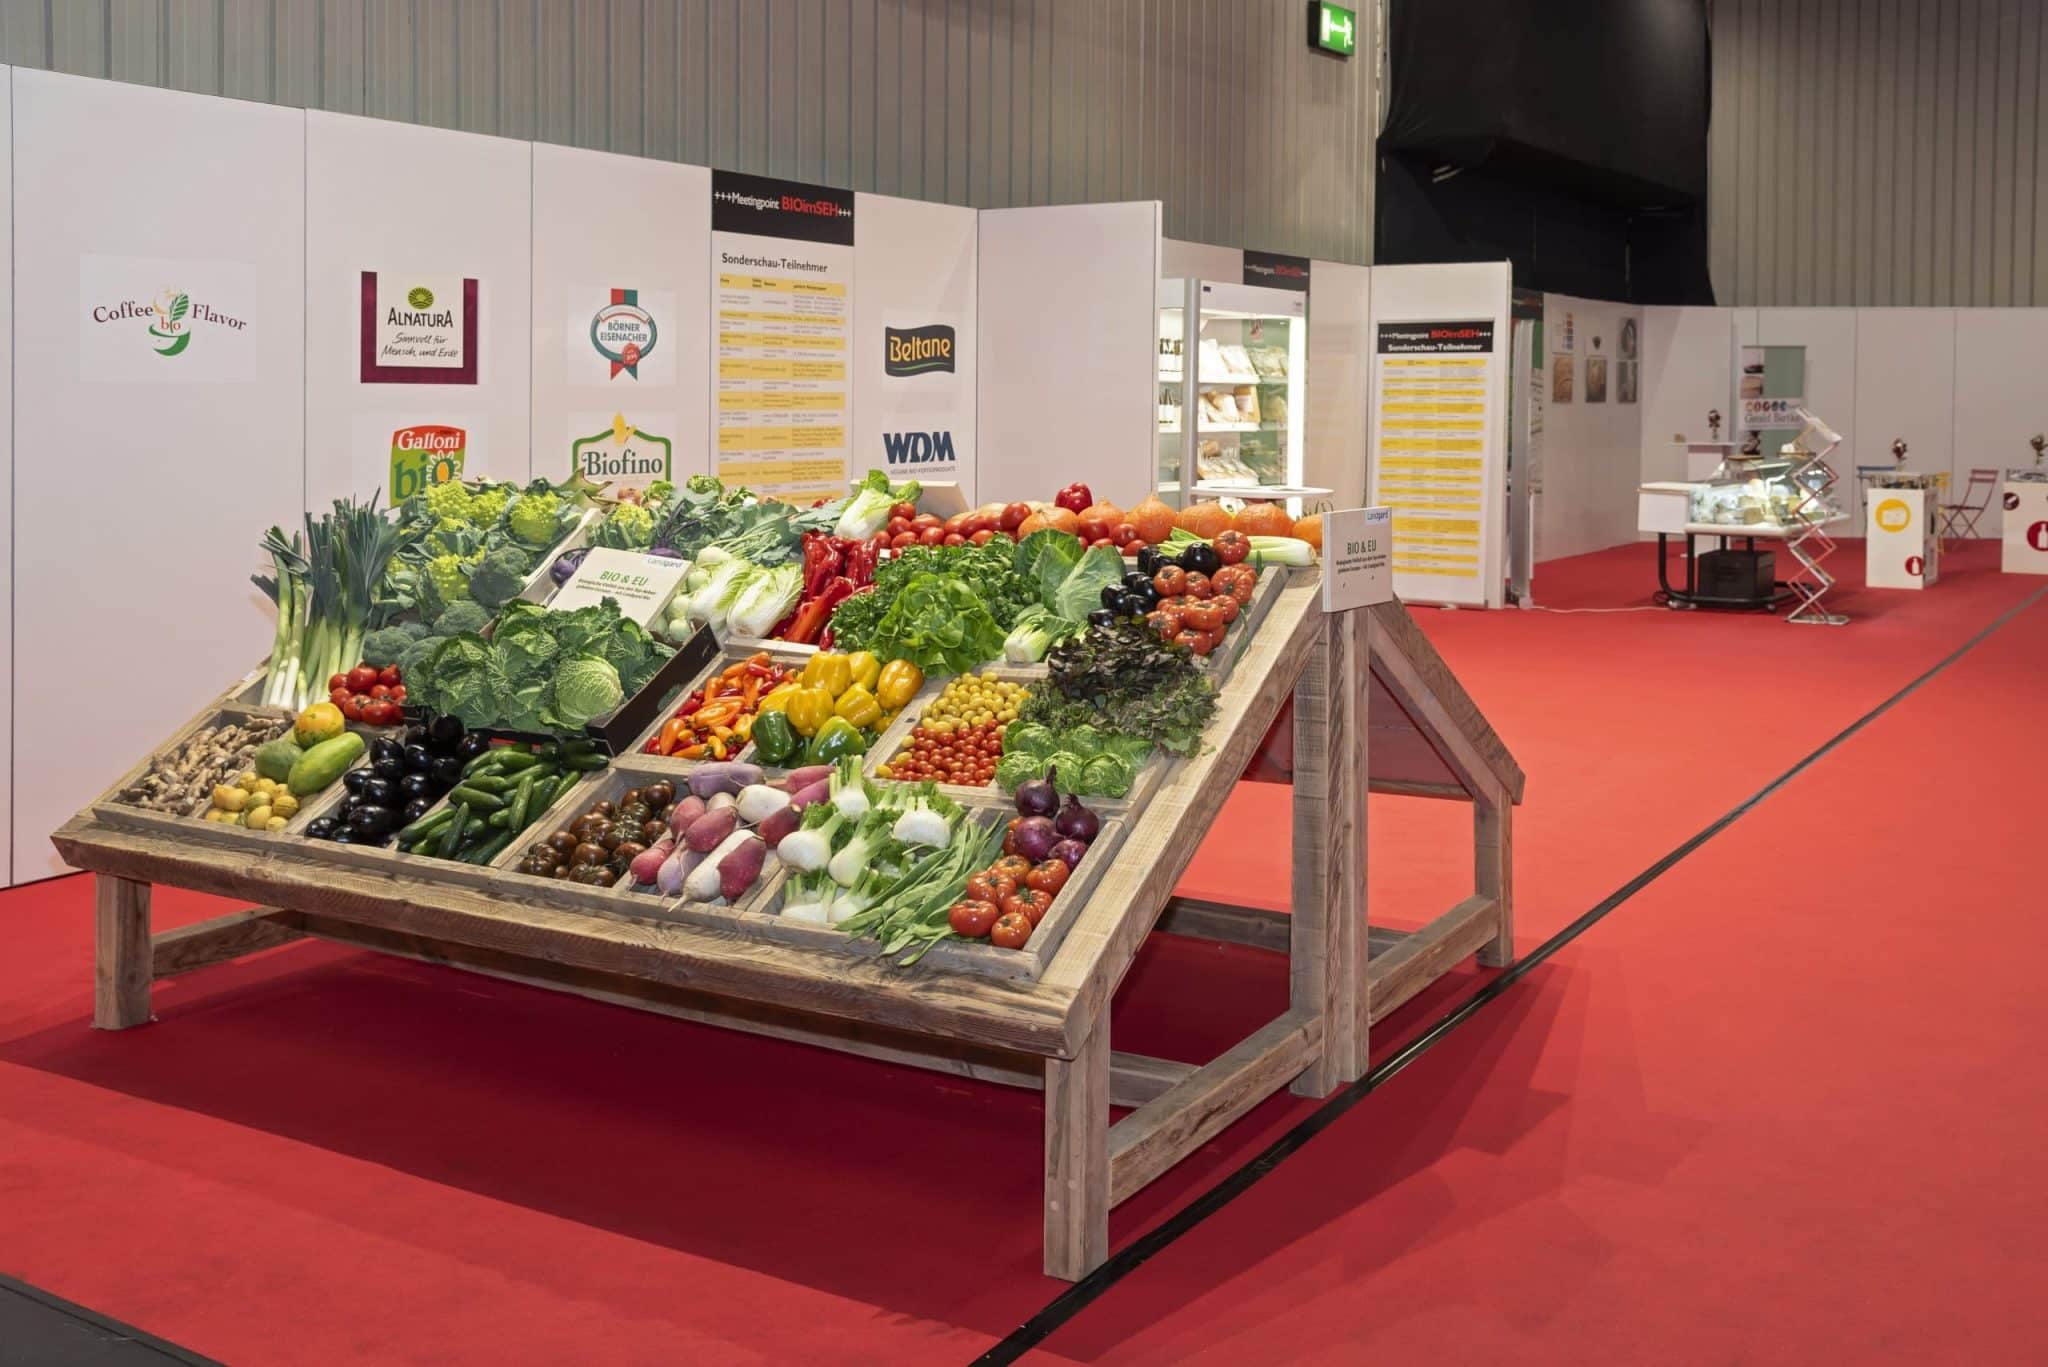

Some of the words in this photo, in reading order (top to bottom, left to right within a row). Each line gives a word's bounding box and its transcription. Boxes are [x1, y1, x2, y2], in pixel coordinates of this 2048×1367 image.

[721, 252, 828, 273] Sonderschau-Teilnehmer
[93, 301, 154, 323] Coffee
[191, 303, 247, 331] Flavor
[387, 307, 454, 328] ALNATURA
[607, 319, 641, 332] BÖRNER
[600, 331, 648, 342] EISENACHER
[418, 347, 438, 357] und
[889, 335, 951, 362] Beltane
[1387, 343, 1483, 352] Sonderschau-Teilnehmer
[397, 430, 461, 450] Galloni
[882, 431, 956, 464] WDM
[581, 449, 663, 476] Biofino
[1347, 542, 1360, 555] BIO
[1361, 541, 1367, 553] &
[1367, 539, 1377, 552] EU
[600, 570, 621, 582] BIO
[621, 575, 630, 584] &
[632, 576, 649, 587] EU
